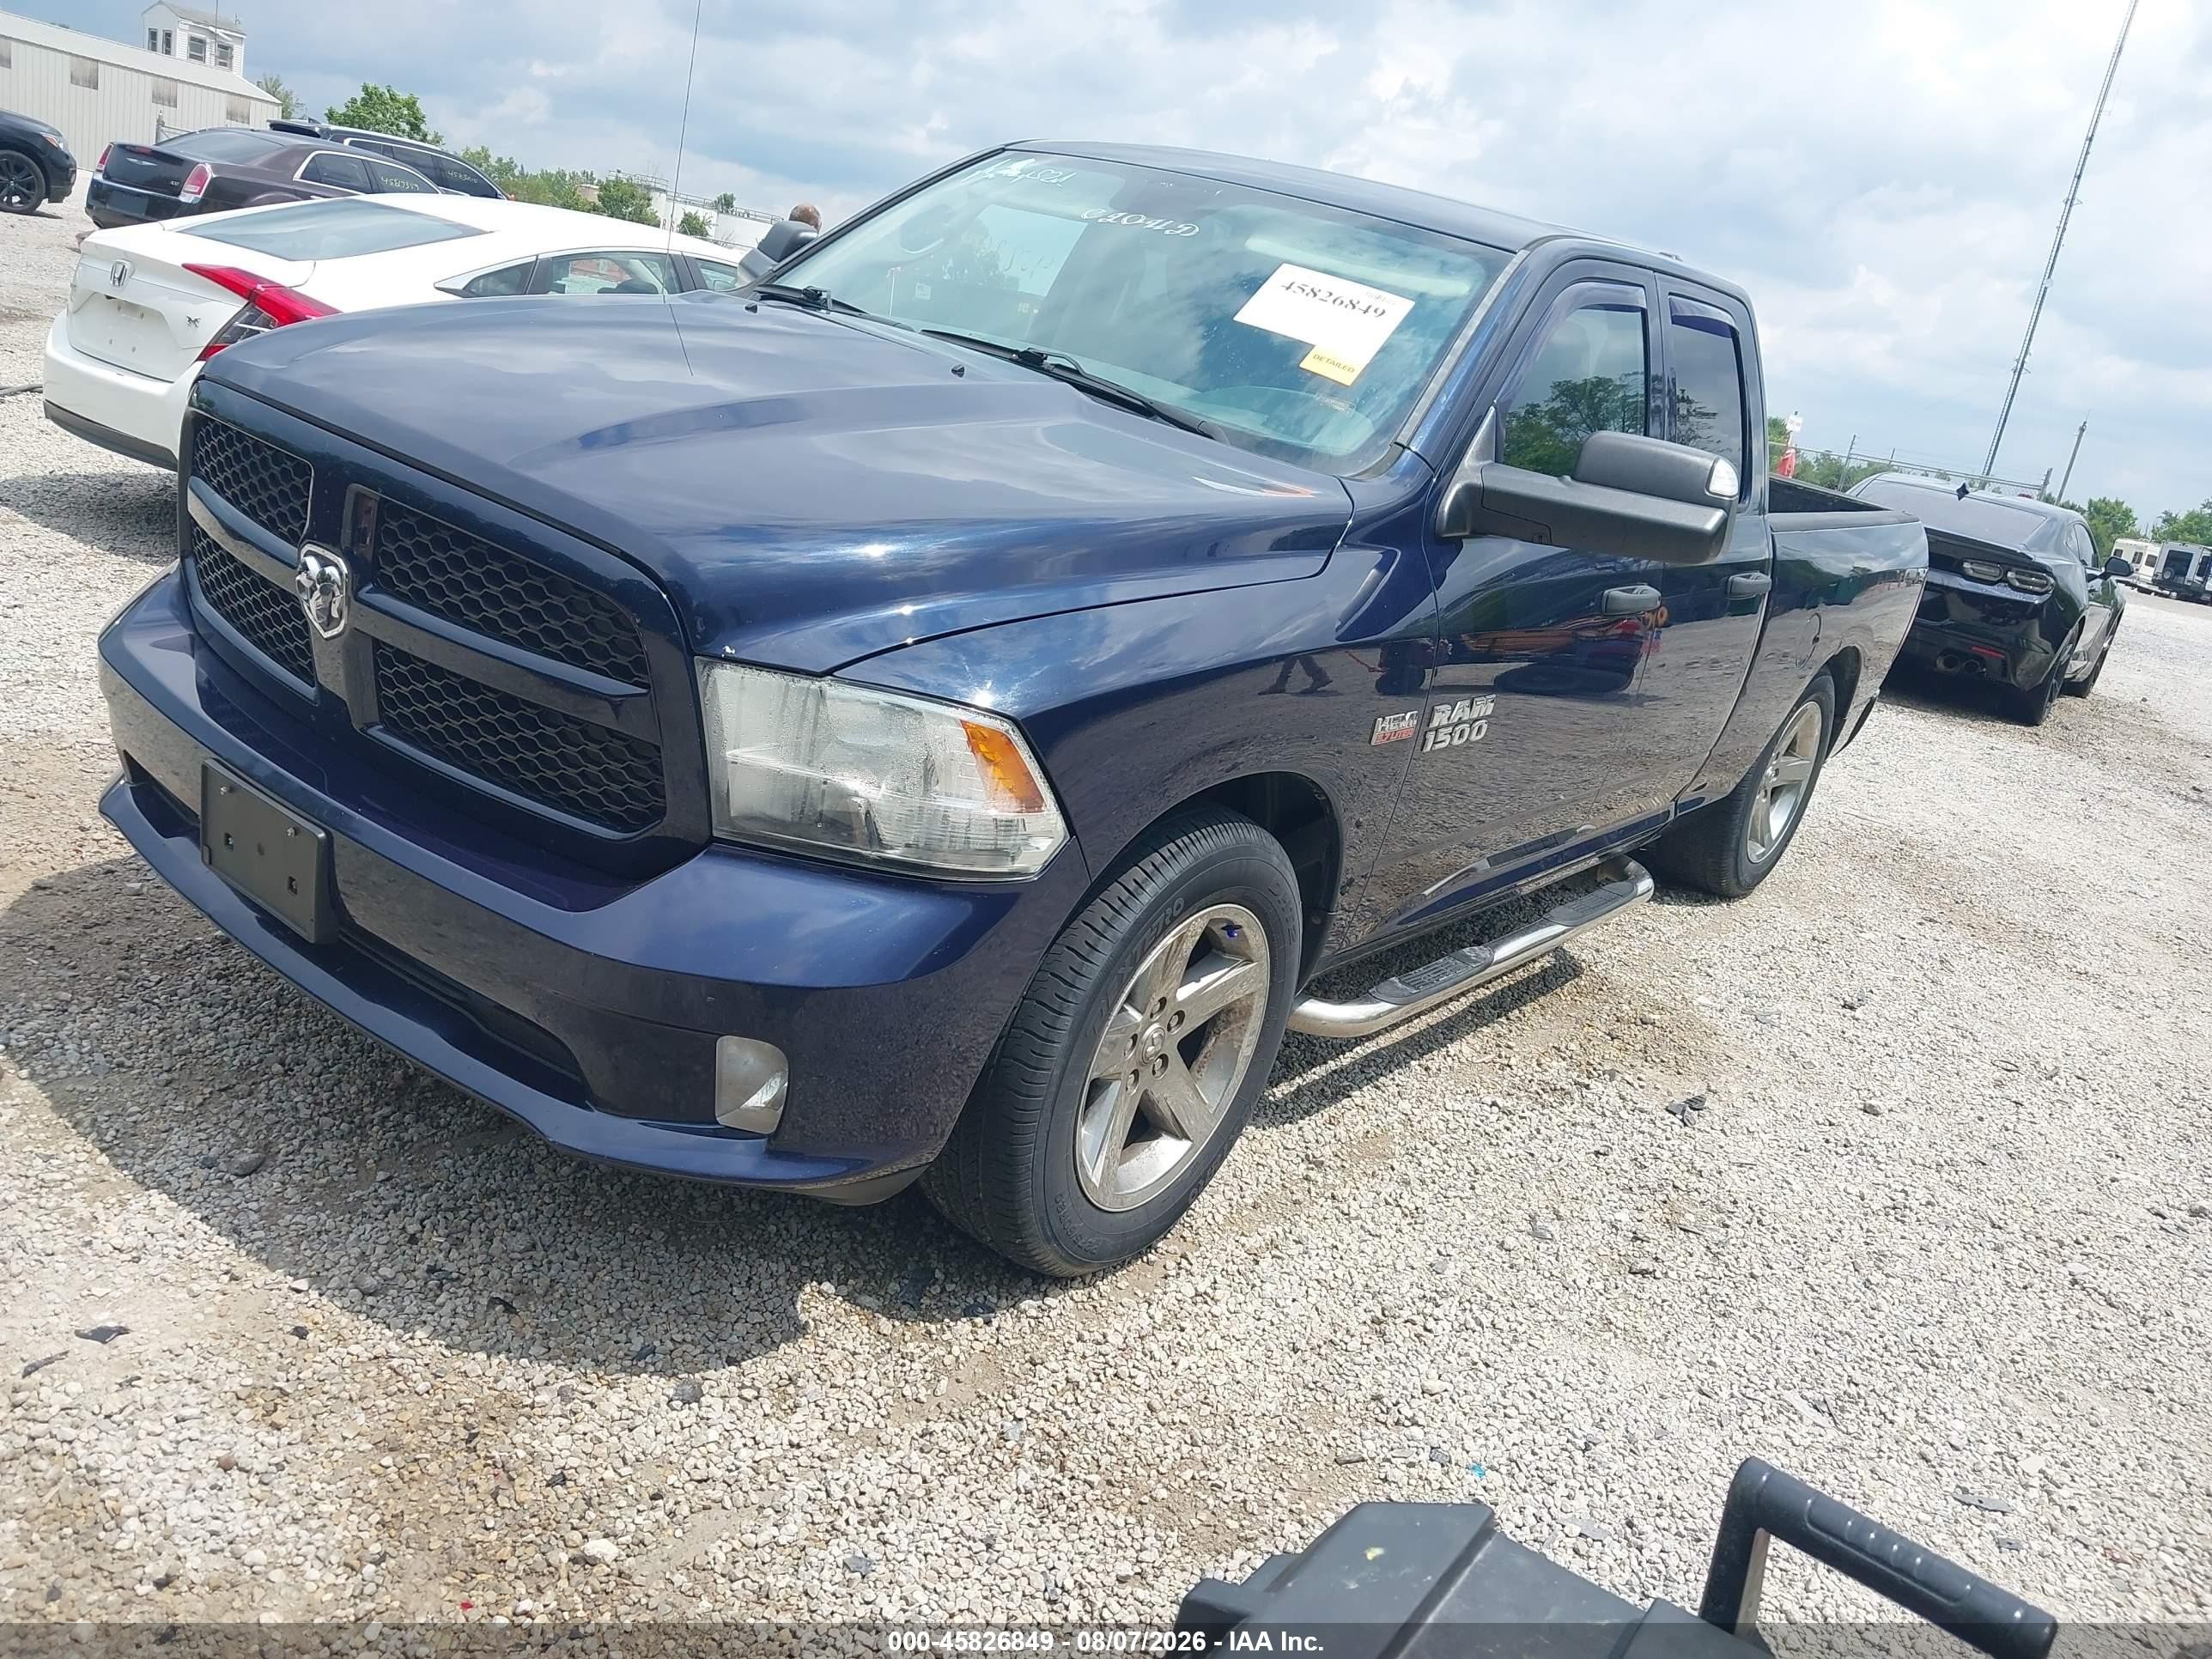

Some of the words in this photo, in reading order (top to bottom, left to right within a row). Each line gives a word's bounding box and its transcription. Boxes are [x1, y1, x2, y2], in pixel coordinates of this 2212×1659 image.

[1280, 281, 1387, 318] 45826849
[1312, 353, 1355, 373] DETAILED
[1375, 711, 1419, 732] HEMI
[1429, 694, 1497, 728] RAM
[1421, 720, 1489, 752] 1500
